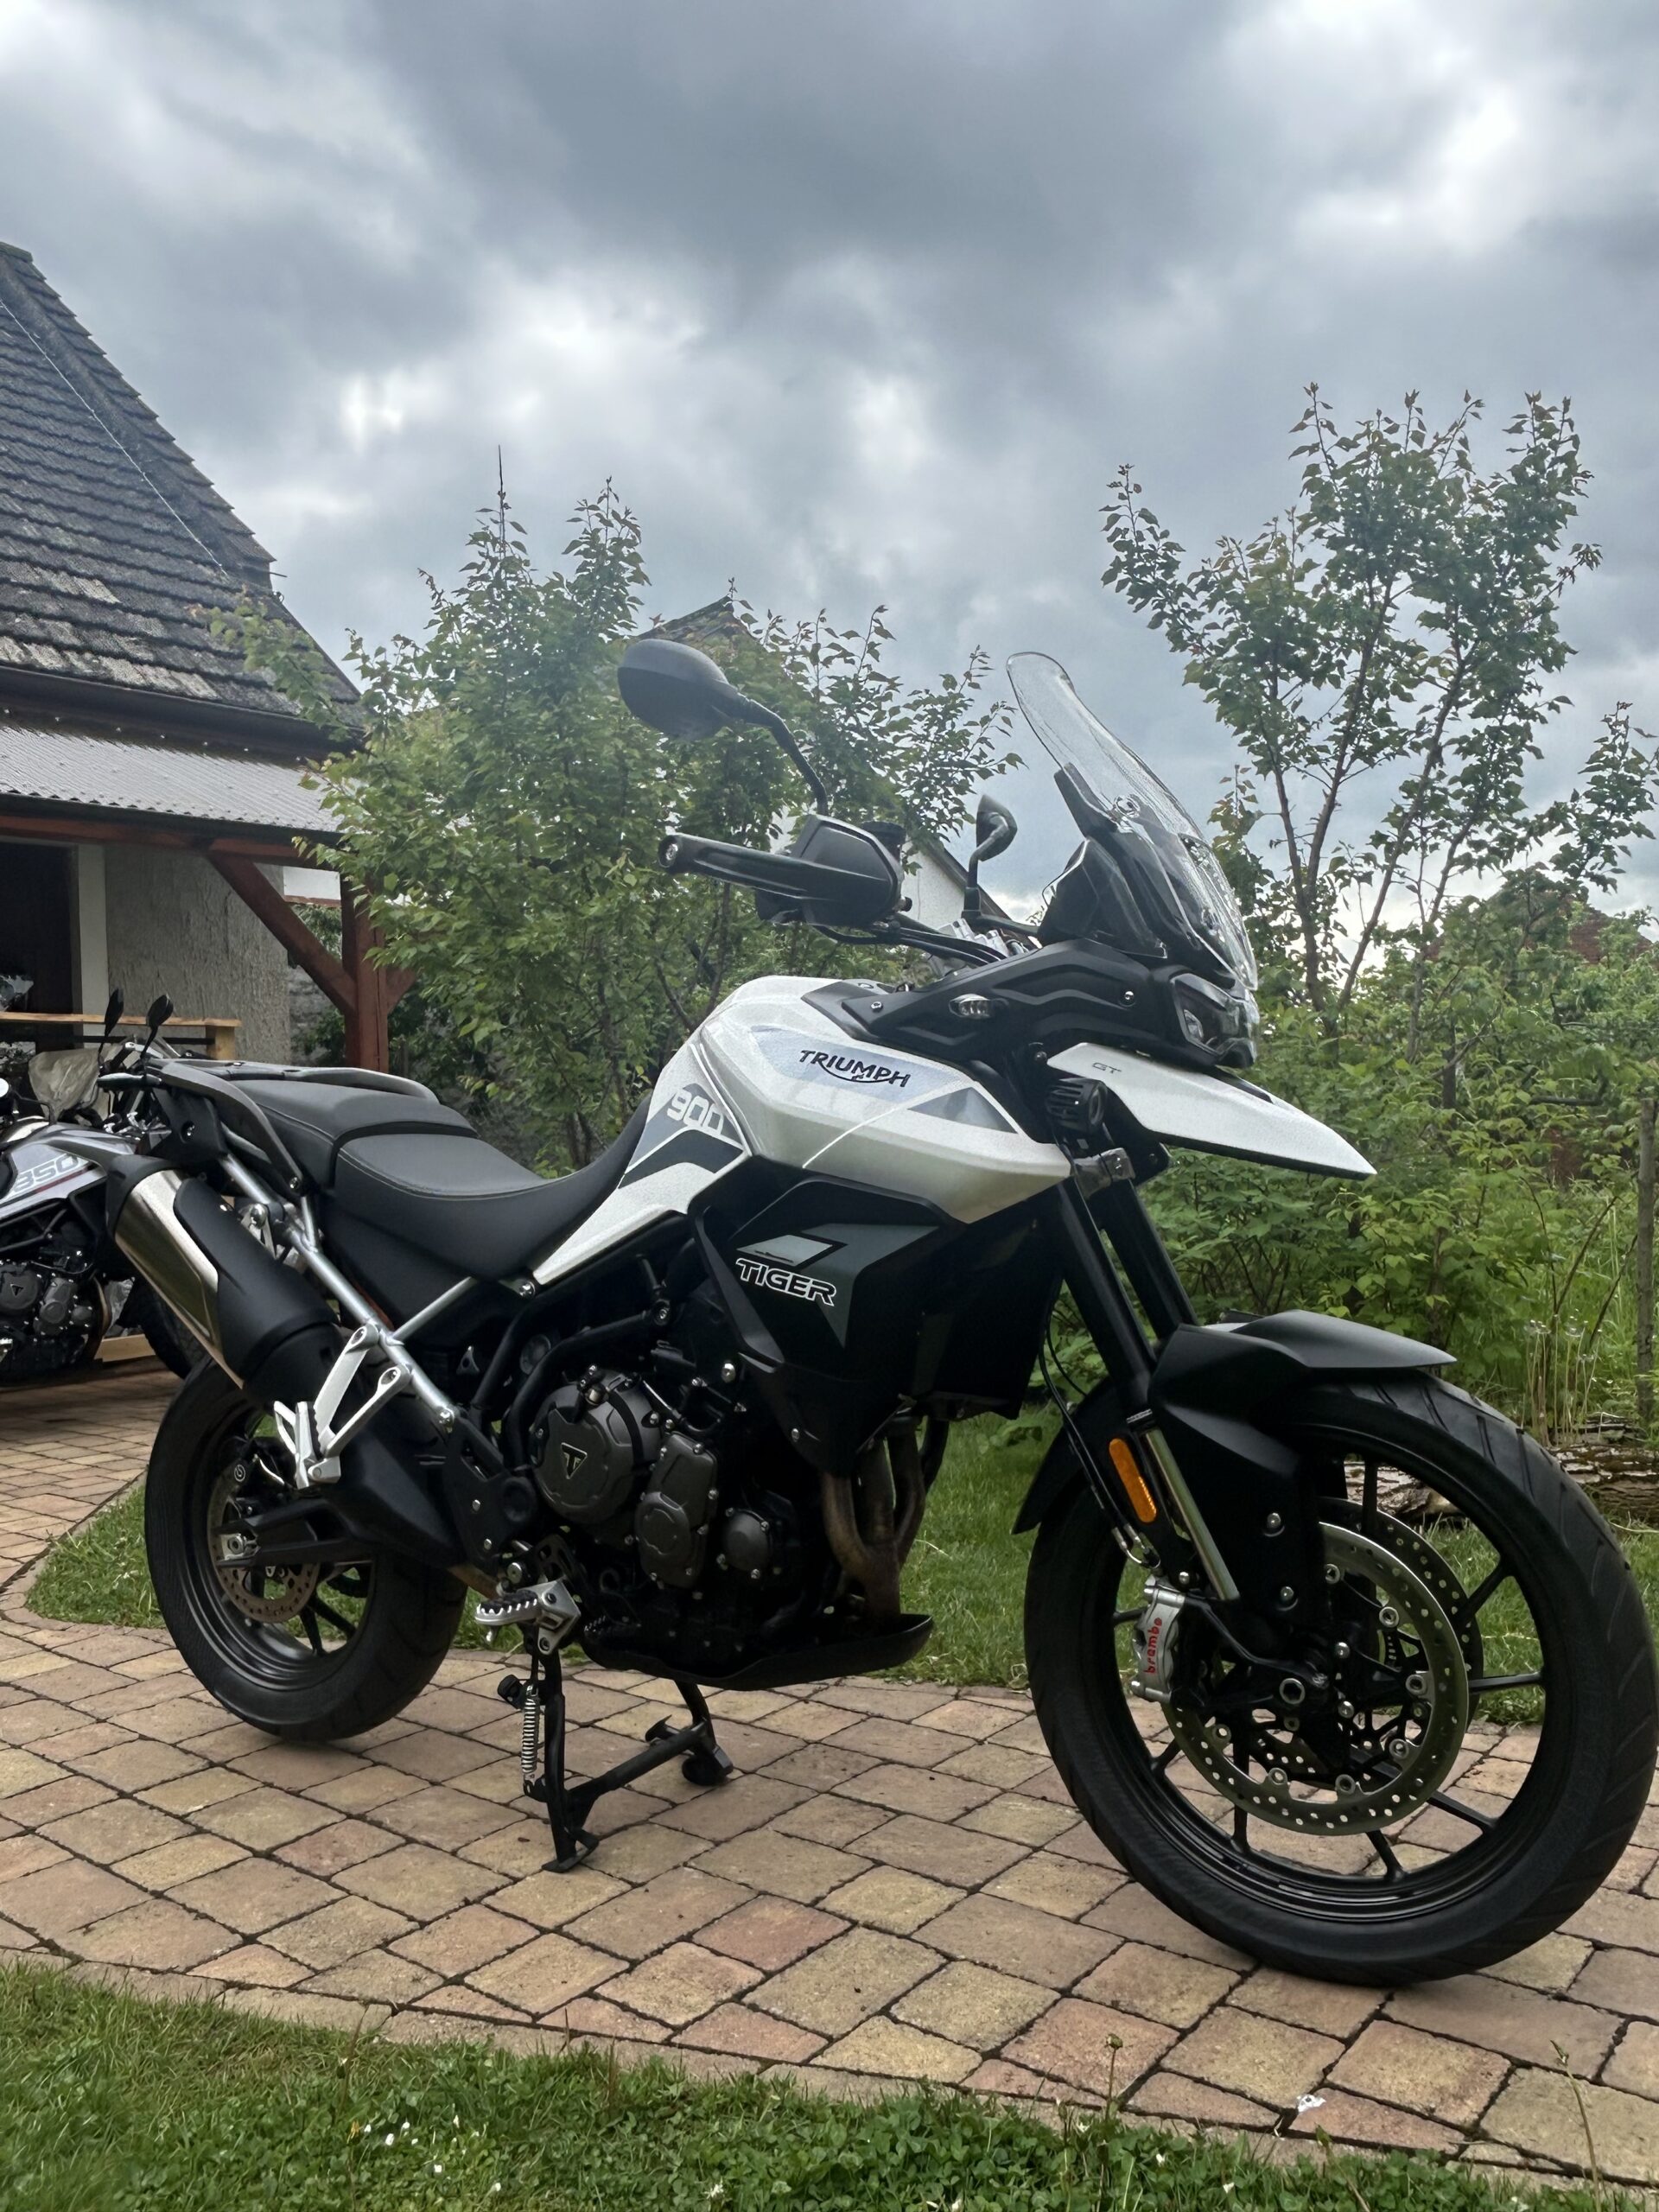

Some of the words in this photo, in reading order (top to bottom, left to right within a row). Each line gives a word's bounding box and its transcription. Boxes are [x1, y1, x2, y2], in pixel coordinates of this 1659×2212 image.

[799, 1050, 911, 1087] TRIUMPH
[1092, 1063, 1122, 1073] GT
[667, 1089, 724, 1136] 900
[735, 1258, 836, 1306] TIGER
[1143, 1618, 1162, 1674] brembo
